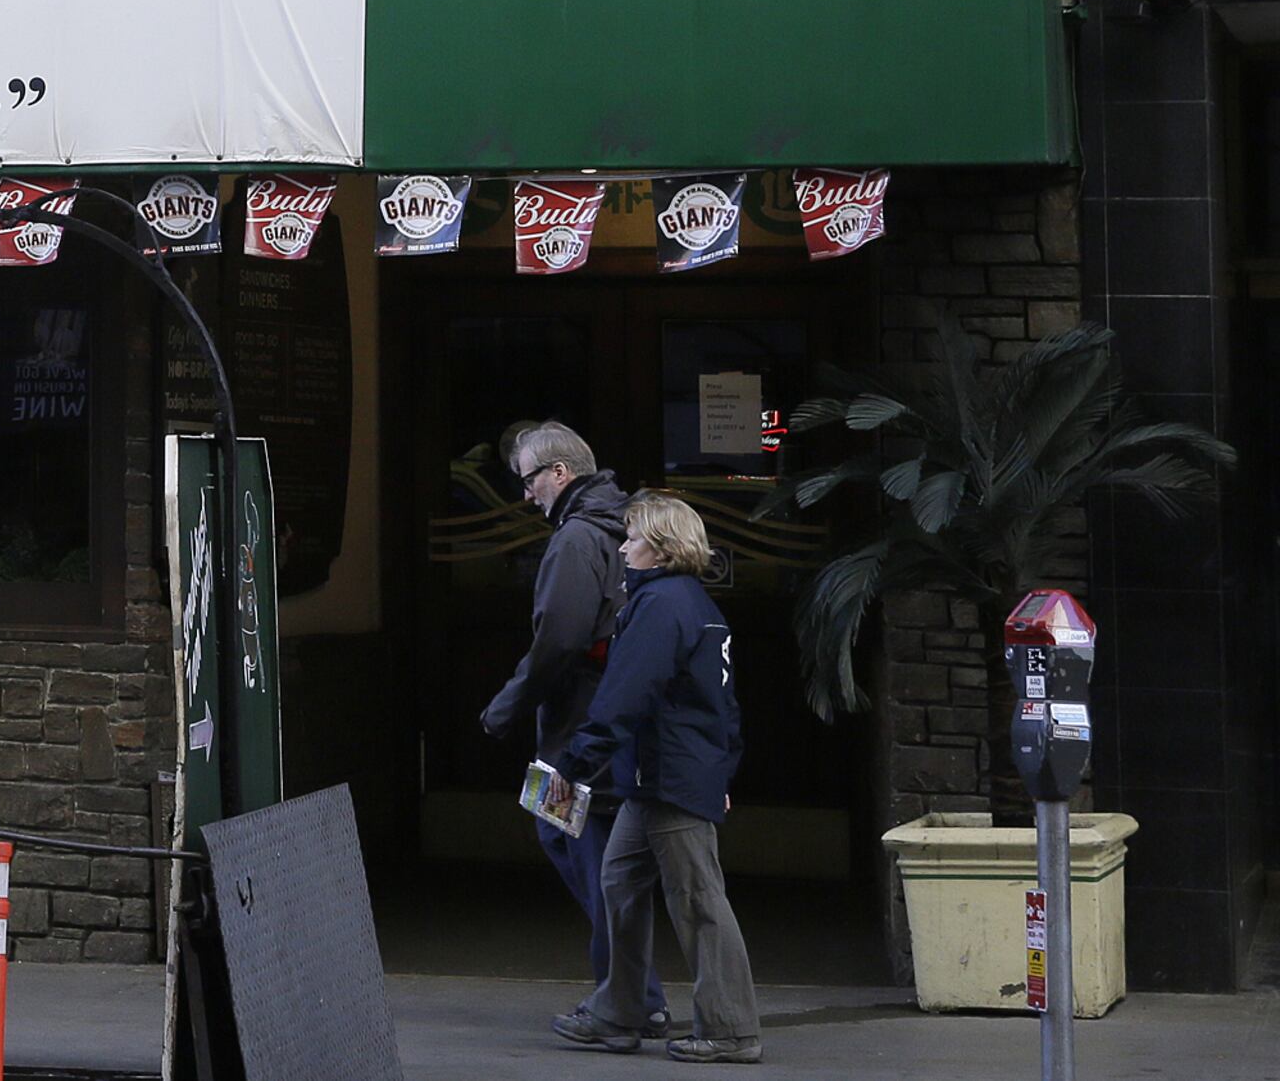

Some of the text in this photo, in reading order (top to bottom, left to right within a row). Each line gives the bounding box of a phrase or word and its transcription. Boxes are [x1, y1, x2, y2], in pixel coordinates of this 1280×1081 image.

[141, 197, 214, 223] GIANTS
[384, 197, 458, 222] GIANTS
[662, 208, 735, 235] GIANTS
[17, 232, 60, 249] GIANTS
[265, 226, 311, 244] GIANTS
[536, 239, 582, 256] GIANTS
